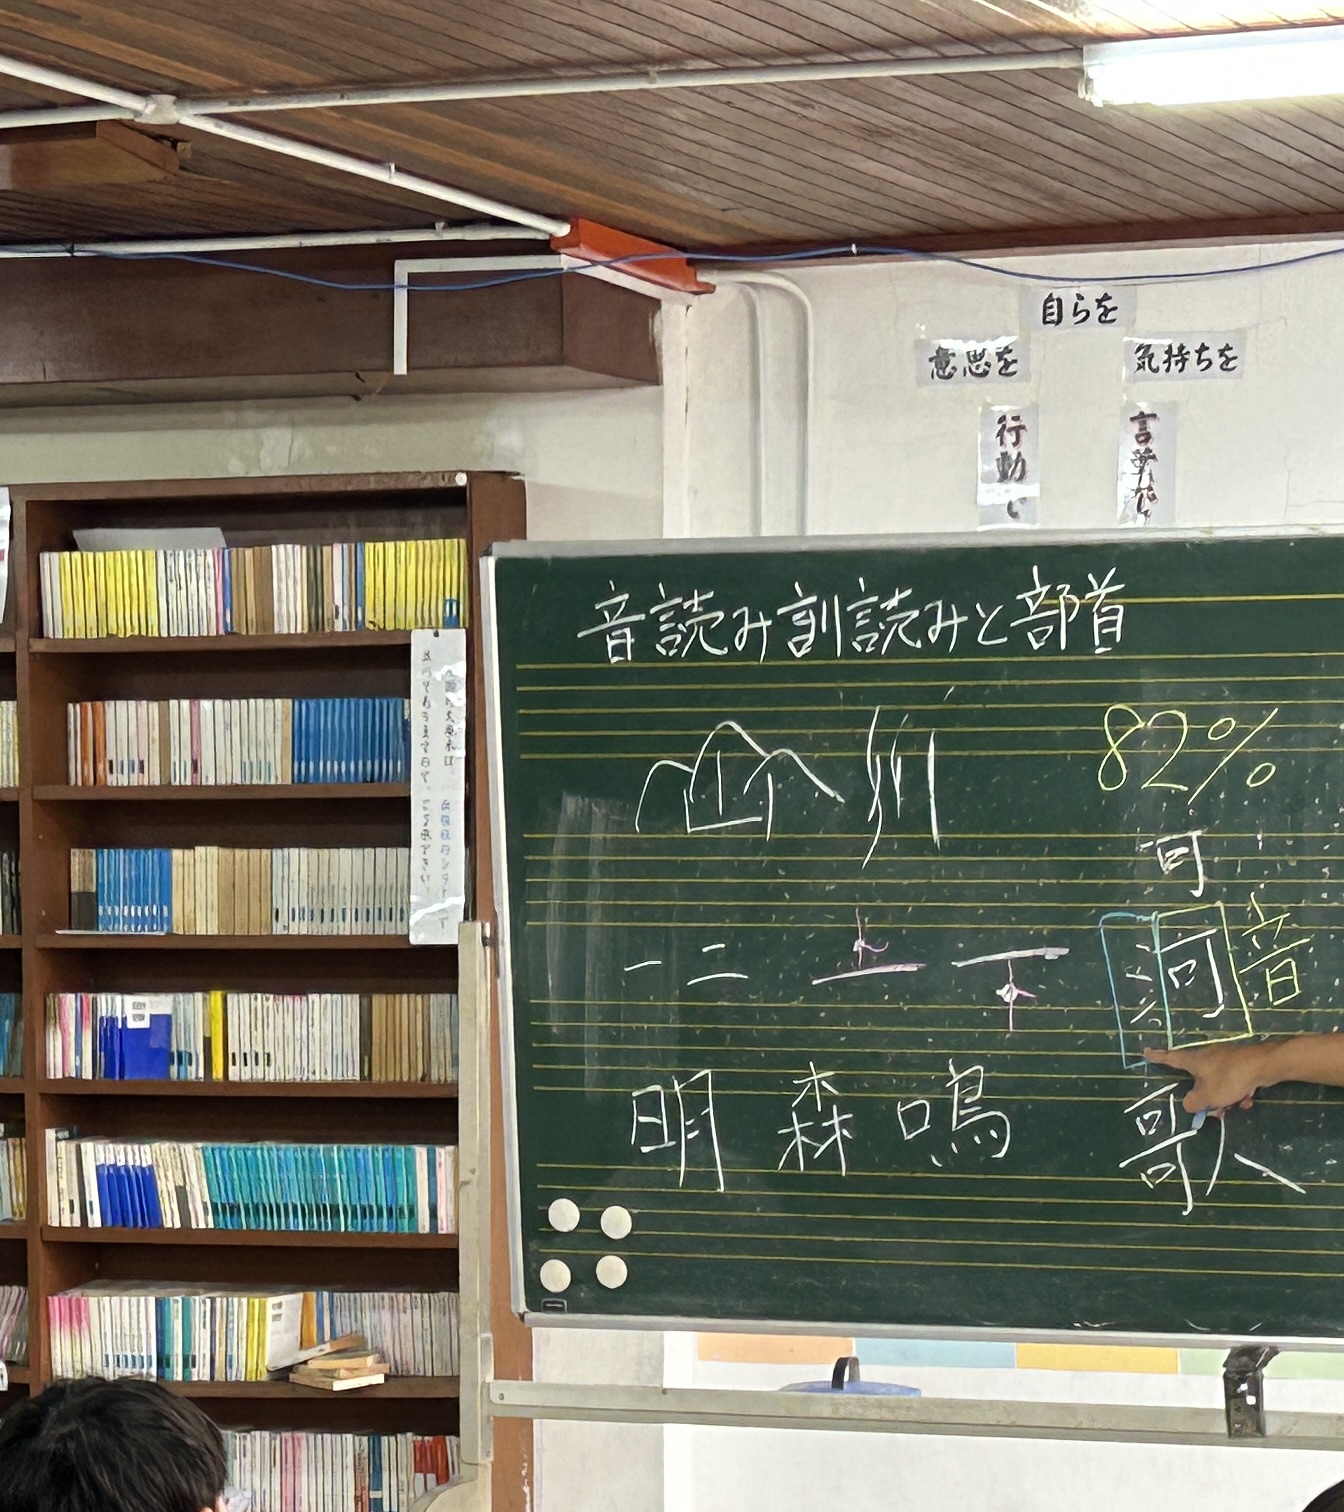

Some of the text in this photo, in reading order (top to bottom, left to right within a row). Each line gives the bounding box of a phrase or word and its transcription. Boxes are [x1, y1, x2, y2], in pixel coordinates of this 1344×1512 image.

[1041, 292, 1119, 326] 自らを
[1133, 343, 1239, 374] 気持ちを
[577, 565, 1128, 663] 音読み訓読みと部首
[1098, 704, 1279, 805] 82%
[631, 1068, 725, 1193] 明
[777, 1061, 855, 1176] 森
